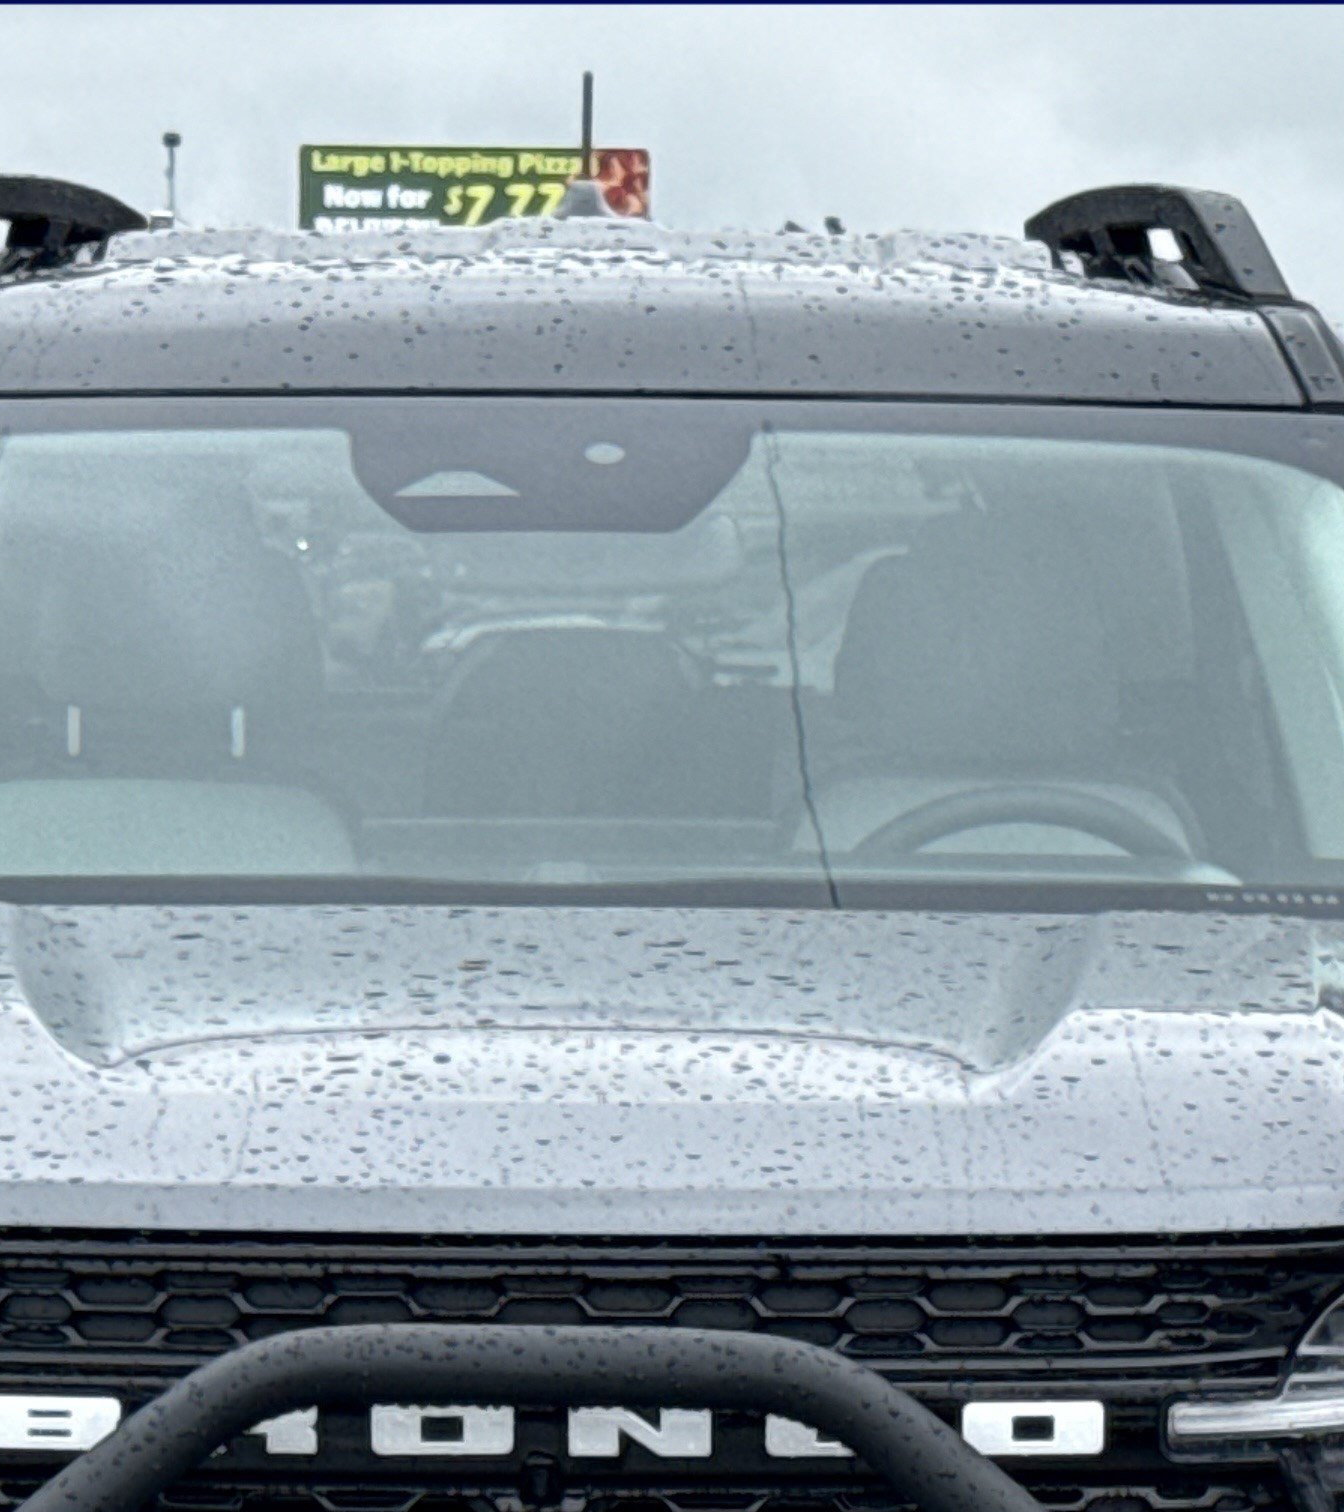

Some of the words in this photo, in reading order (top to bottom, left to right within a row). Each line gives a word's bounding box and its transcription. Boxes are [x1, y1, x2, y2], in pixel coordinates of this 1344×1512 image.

[311, 150, 385, 177] Large
[323, 184, 383, 209] Now
[387, 184, 432, 209] for
